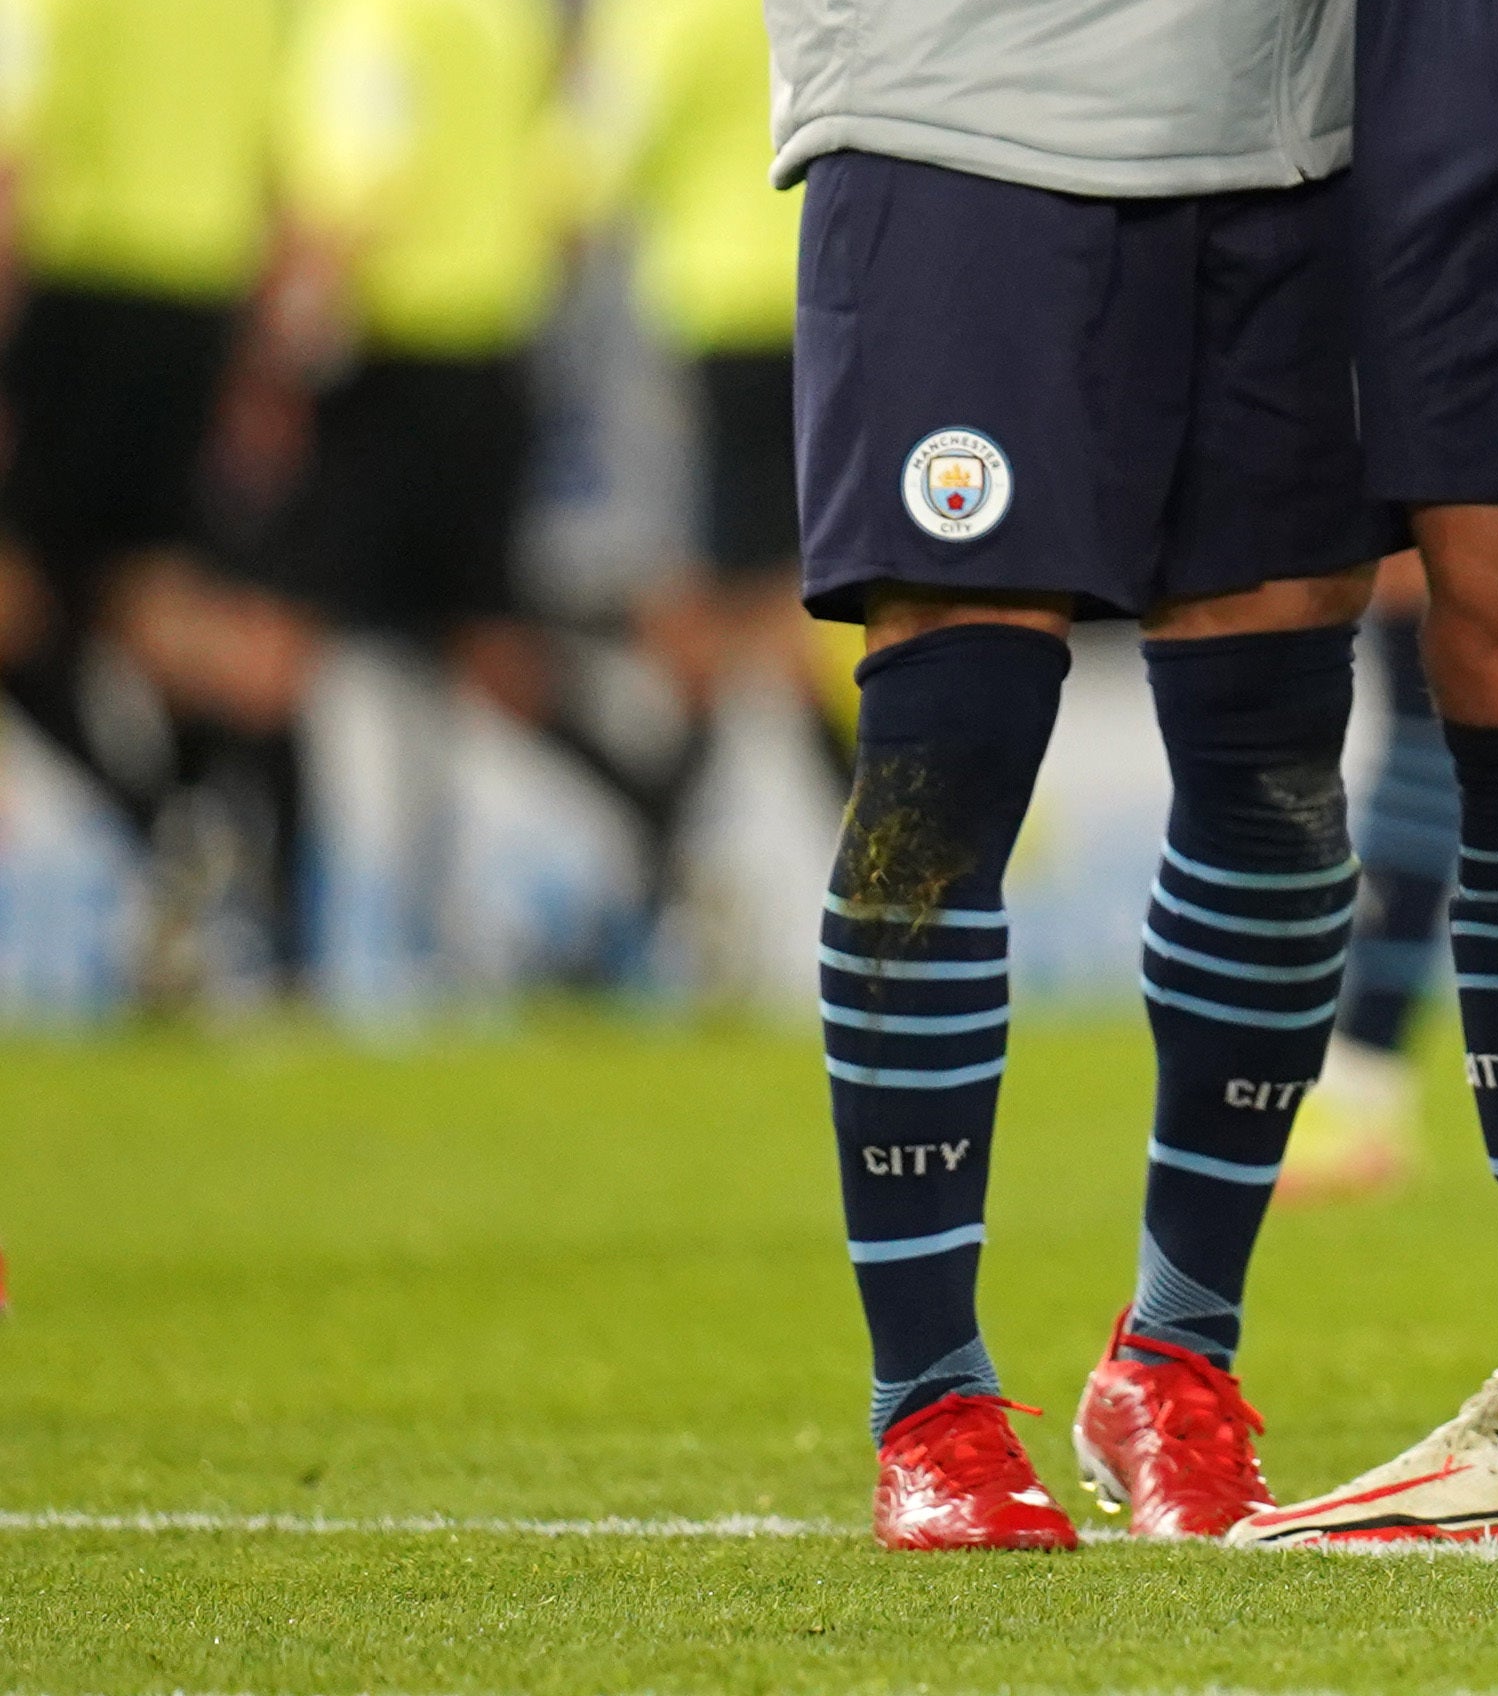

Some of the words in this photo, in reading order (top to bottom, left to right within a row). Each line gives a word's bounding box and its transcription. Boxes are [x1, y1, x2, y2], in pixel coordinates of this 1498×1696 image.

[913, 435, 1001, 470] MANCHESTER
[940, 522, 973, 534] CITY
[861, 1137, 971, 1177] CITY
